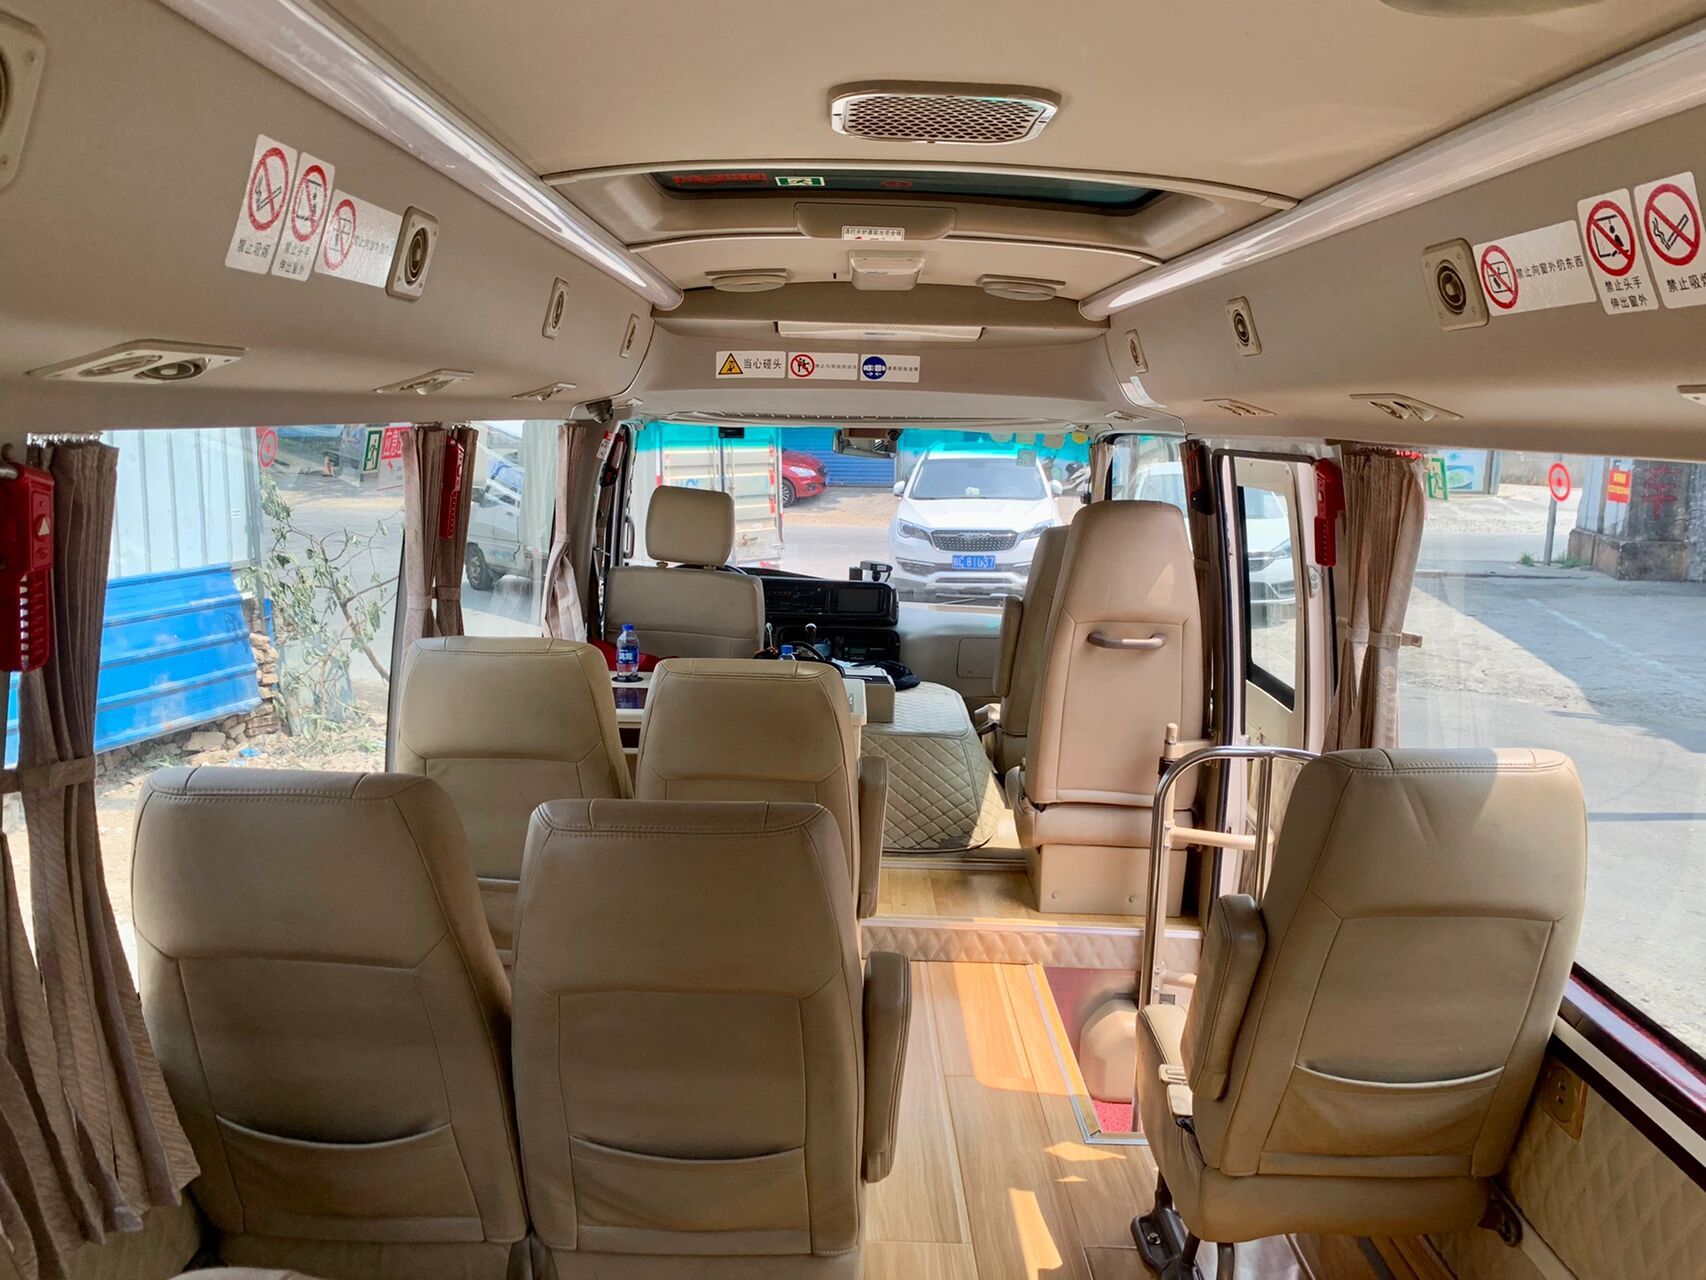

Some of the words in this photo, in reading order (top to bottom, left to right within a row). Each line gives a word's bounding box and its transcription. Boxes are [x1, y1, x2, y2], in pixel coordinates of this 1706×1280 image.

[1605, 277, 1642, 293] 禁止头手
[1610, 294, 1648, 309] 伸出窗外
[743, 358, 782, 370] 当心碰头
